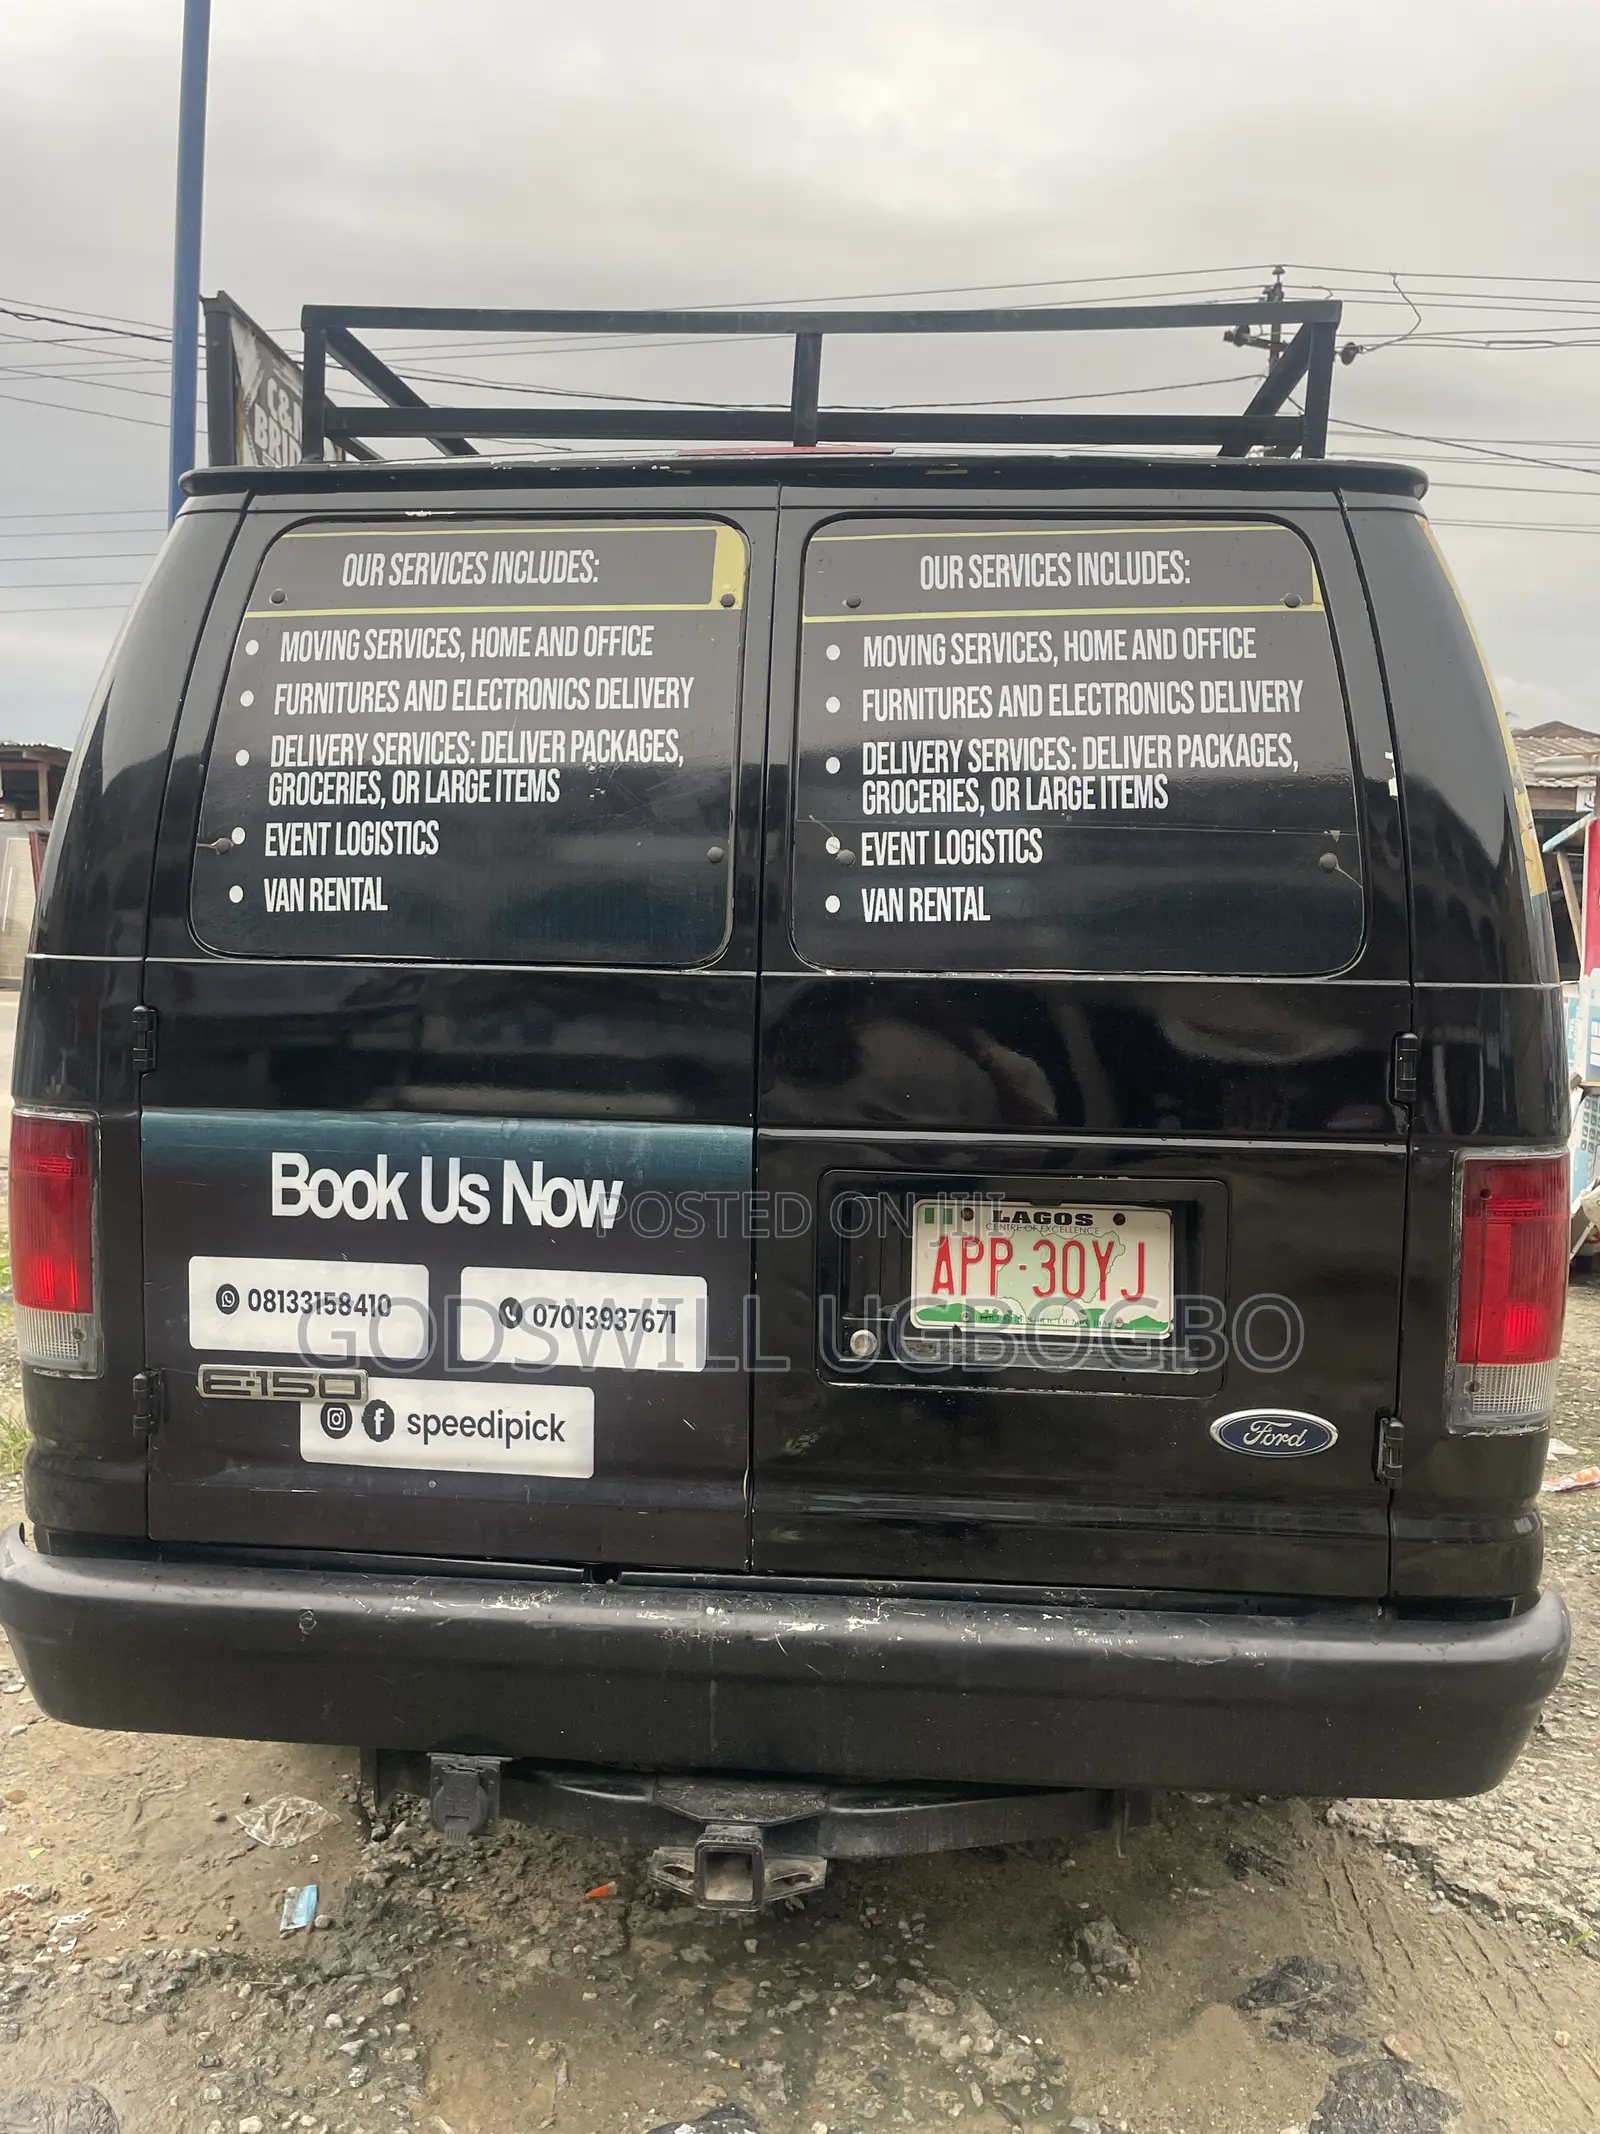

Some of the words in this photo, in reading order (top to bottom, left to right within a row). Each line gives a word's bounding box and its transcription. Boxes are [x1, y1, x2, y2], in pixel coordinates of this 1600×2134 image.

[343, 553, 385, 587] OUR
[389, 551, 488, 586] SERVICES
[492, 550, 599, 584] INCLUDES:
[921, 555, 963, 590] OUR
[969, 552, 1071, 588] SERVICES
[1077, 550, 1190, 585] INCLUDES:
[280, 629, 360, 662] MOVING
[364, 627, 465, 662] SERVICES,
[471, 627, 532, 657] HOME
[535, 626, 578, 657] AND
[584, 625, 654, 656] OFFICE
[864, 633, 945, 667] MOVING
[951, 631, 1058, 667] SERVICES,
[1064, 630, 1127, 661] HOME
[1132, 629, 1177, 660] AND
[1183, 627, 1256, 659] OFFICE
[274, 680, 400, 715] FURNITURES
[404, 680, 447, 711] AND
[452, 677, 590, 711] ELECTRONICS
[596, 677, 694, 709] DELIVERY
[863, 685, 992, 721] FURNITURES
[998, 685, 1042, 717] AND
[1049, 681, 1194, 716] ELECTRONICS
[1200, 680, 1303, 713] DELIVERY
[271, 733, 368, 767] DELIVERY
[372, 731, 475, 765] SERVICES:
[481, 730, 565, 763] DELIVER
[571, 729, 683, 767] PACKAGES,
[863, 739, 963, 775] DELIVERY
[968, 736, 1076, 772] SERVICES:
[1083, 735, 1172, 769] DELIVER
[1178, 733, 1298, 772] PACKAGES,
[269, 771, 385, 809] GROCERIES,
[392, 770, 419, 804] OR
[425, 769, 492, 803] LARGE
[496, 768, 560, 802] ITEMS
[863, 778, 984, 817] GROCERIES,
[991, 777, 1020, 812] OR
[1026, 776, 1095, 810] LARGE
[1101, 774, 1168, 809] ITEMS
[265, 822, 331, 856] EVENT
[335, 820, 439, 855] LOGISTICS
[862, 831, 929, 866] EVENT
[935, 828, 1042, 864] LOGISTICS
[264, 878, 304, 912] VAN
[310, 877, 388, 911] RENTAL
[862, 888, 903, 922] VAN
[910, 887, 990, 921] RENTAL
[271, 1151, 408, 1221] Book
[420, 1156, 491, 1225] Us
[502, 1160, 624, 1229] Now
[986, 1222, 1023, 1232] CENTRE
[1024, 1224, 1038, 1232] OF
[1040, 1224, 1101, 1235] EXCELLENCE
[992, 1210, 1094, 1226] LAGOS
[247, 1287, 392, 1318] 08133158410
[533, 1304, 677, 1334] 07013937671
[203, 1368, 363, 1399] E-150
[406, 1408, 566, 1449] speedipick
[1242, 1419, 1308, 1449] Ford
